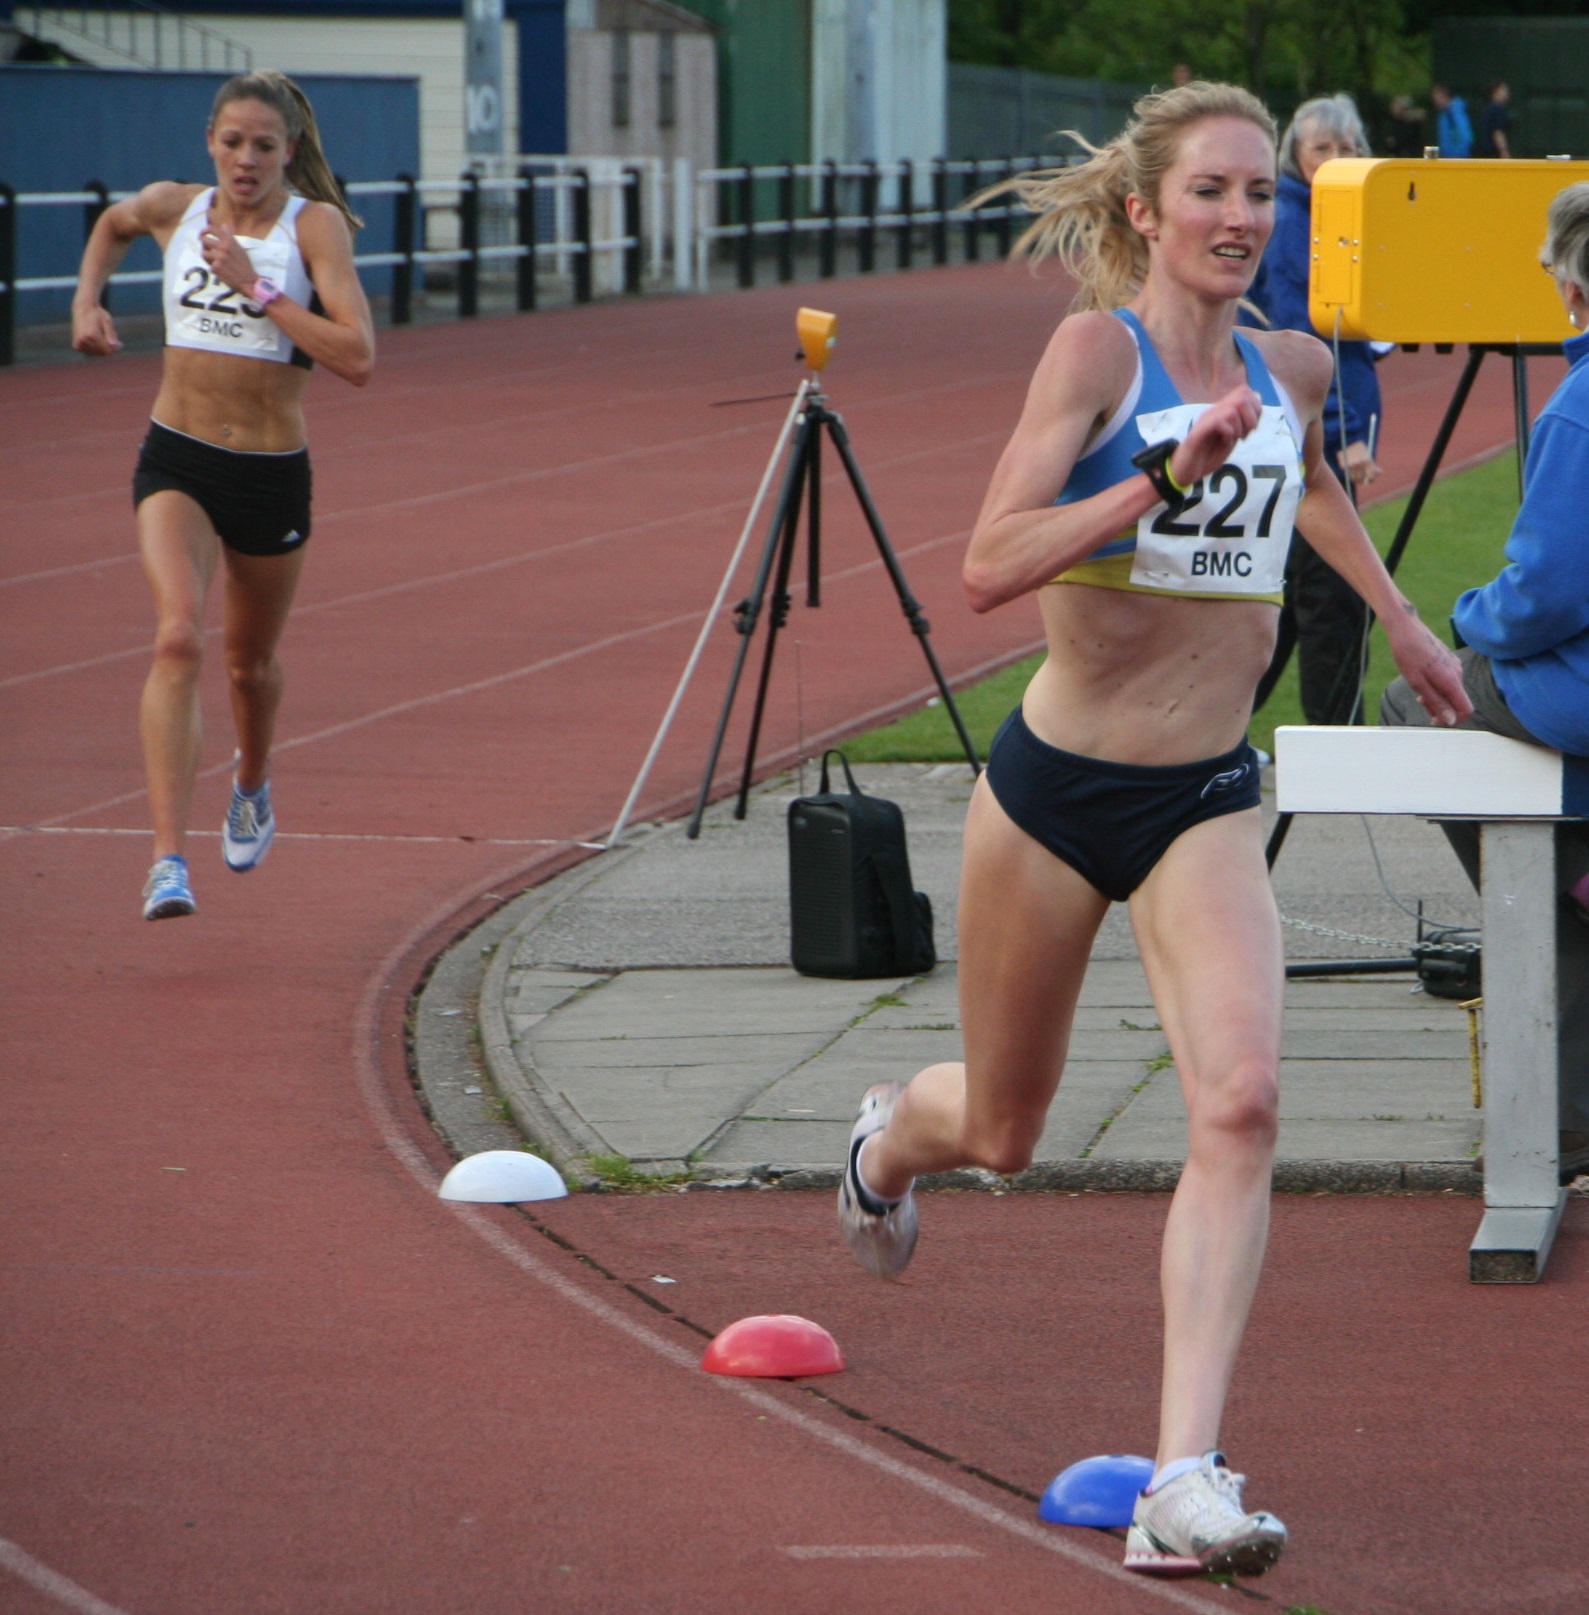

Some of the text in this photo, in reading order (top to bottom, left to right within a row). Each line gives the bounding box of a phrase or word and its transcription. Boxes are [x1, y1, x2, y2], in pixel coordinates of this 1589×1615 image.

[200, 318, 243, 338] BMC
[1151, 463, 1286, 538] 227
[1191, 551, 1252, 577] BMC
